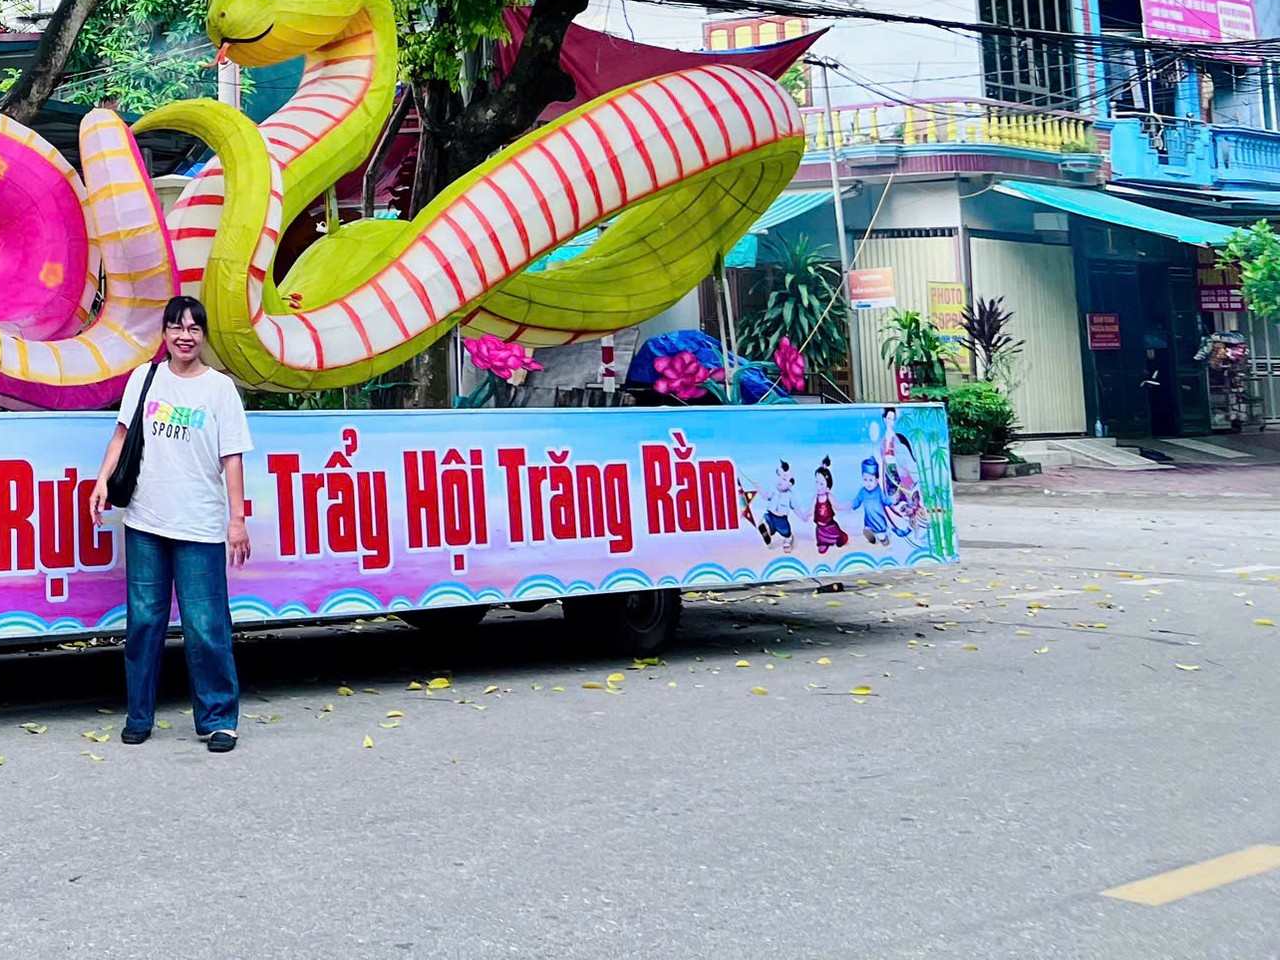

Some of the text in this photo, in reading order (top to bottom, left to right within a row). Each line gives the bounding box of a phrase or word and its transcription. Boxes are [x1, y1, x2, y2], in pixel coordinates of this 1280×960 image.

[931, 287, 962, 305] PHOTO
[266, 428, 391, 570] Trẩy
[402, 448, 488, 571] Hội
[497, 448, 634, 554] Trăng
[641, 431, 740, 535] Rằm
